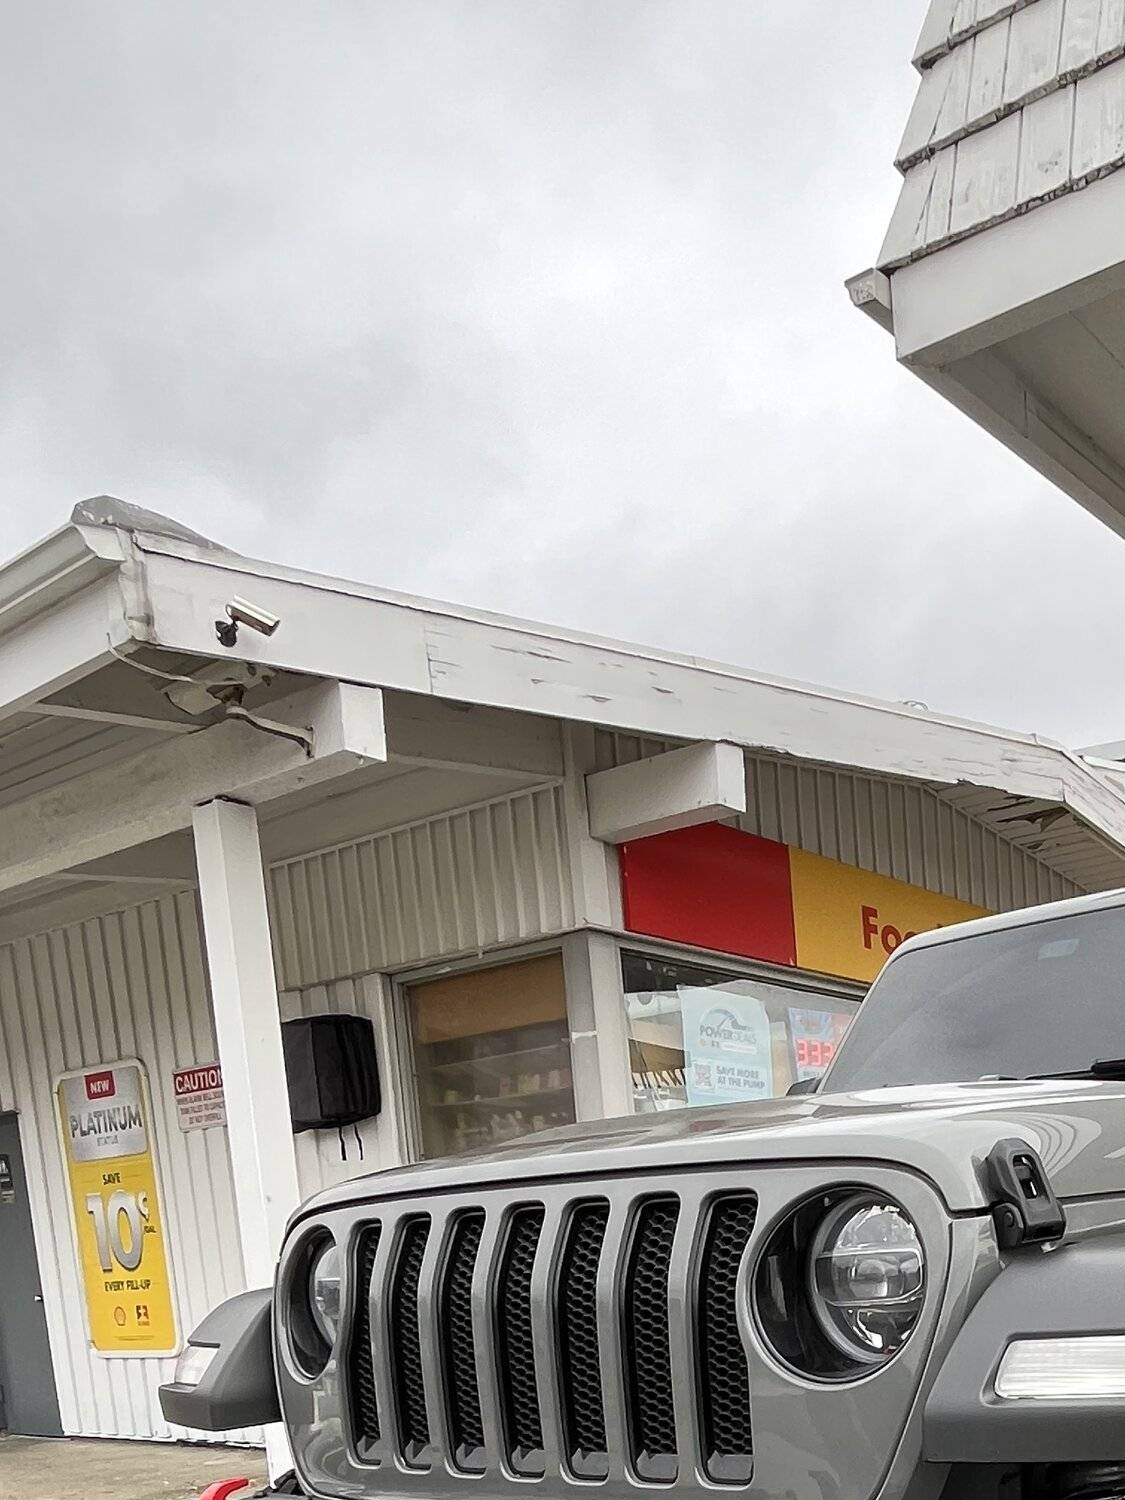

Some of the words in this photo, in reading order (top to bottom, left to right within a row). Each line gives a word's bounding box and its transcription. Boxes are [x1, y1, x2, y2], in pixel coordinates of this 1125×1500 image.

[90, 1080, 110, 1094] NEW
[70, 1104, 142, 1138] PLATINUM
[103, 1172, 121, 1185] SAVE
[104, 1280, 124, 1292] EVERY
[127, 1279, 151, 1291] FILL-UP
